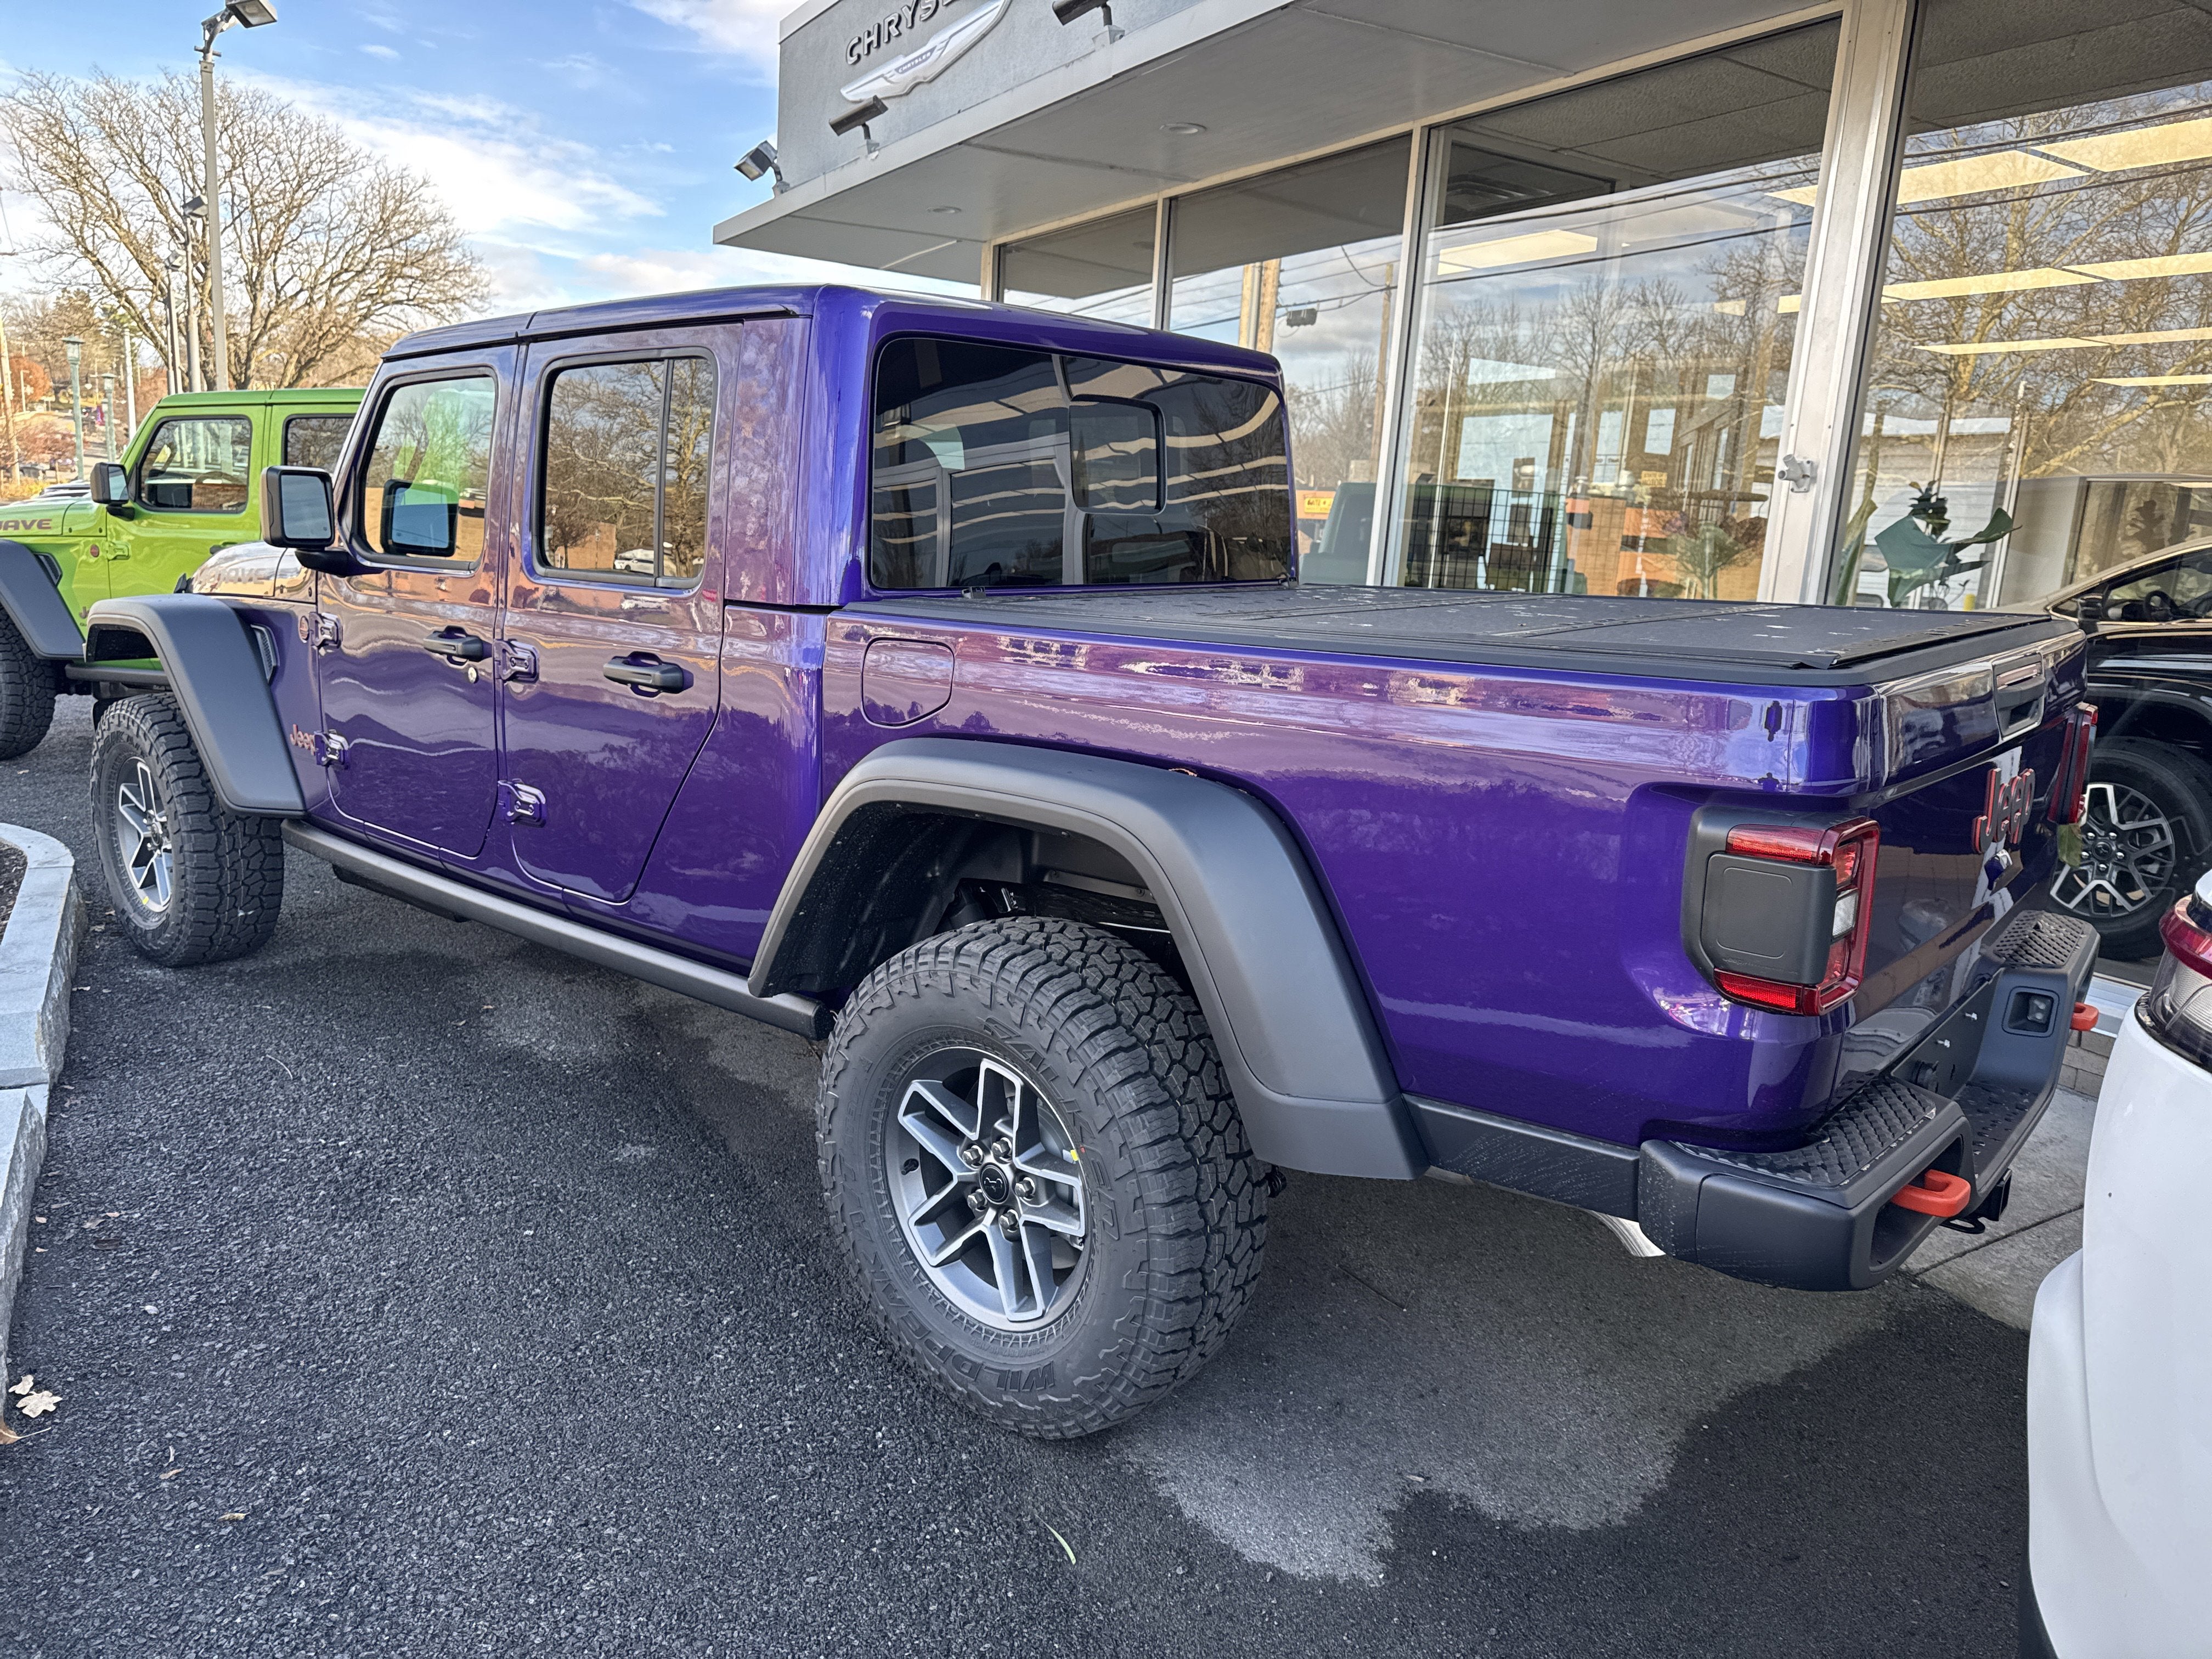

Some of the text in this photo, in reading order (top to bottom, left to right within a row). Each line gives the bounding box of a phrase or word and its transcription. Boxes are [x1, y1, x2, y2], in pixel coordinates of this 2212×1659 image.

[845, 0, 953, 65] CHRYS
[898, 52, 932, 73] CHRYSLER
[196, 567, 265, 585] MOJAVE
[290, 724, 315, 756] Jeep
[1972, 768, 2035, 854] Jeep
[983, 1015, 1120, 1242] FALKEN
[865, 1253, 1056, 1392] WILDPEAK
